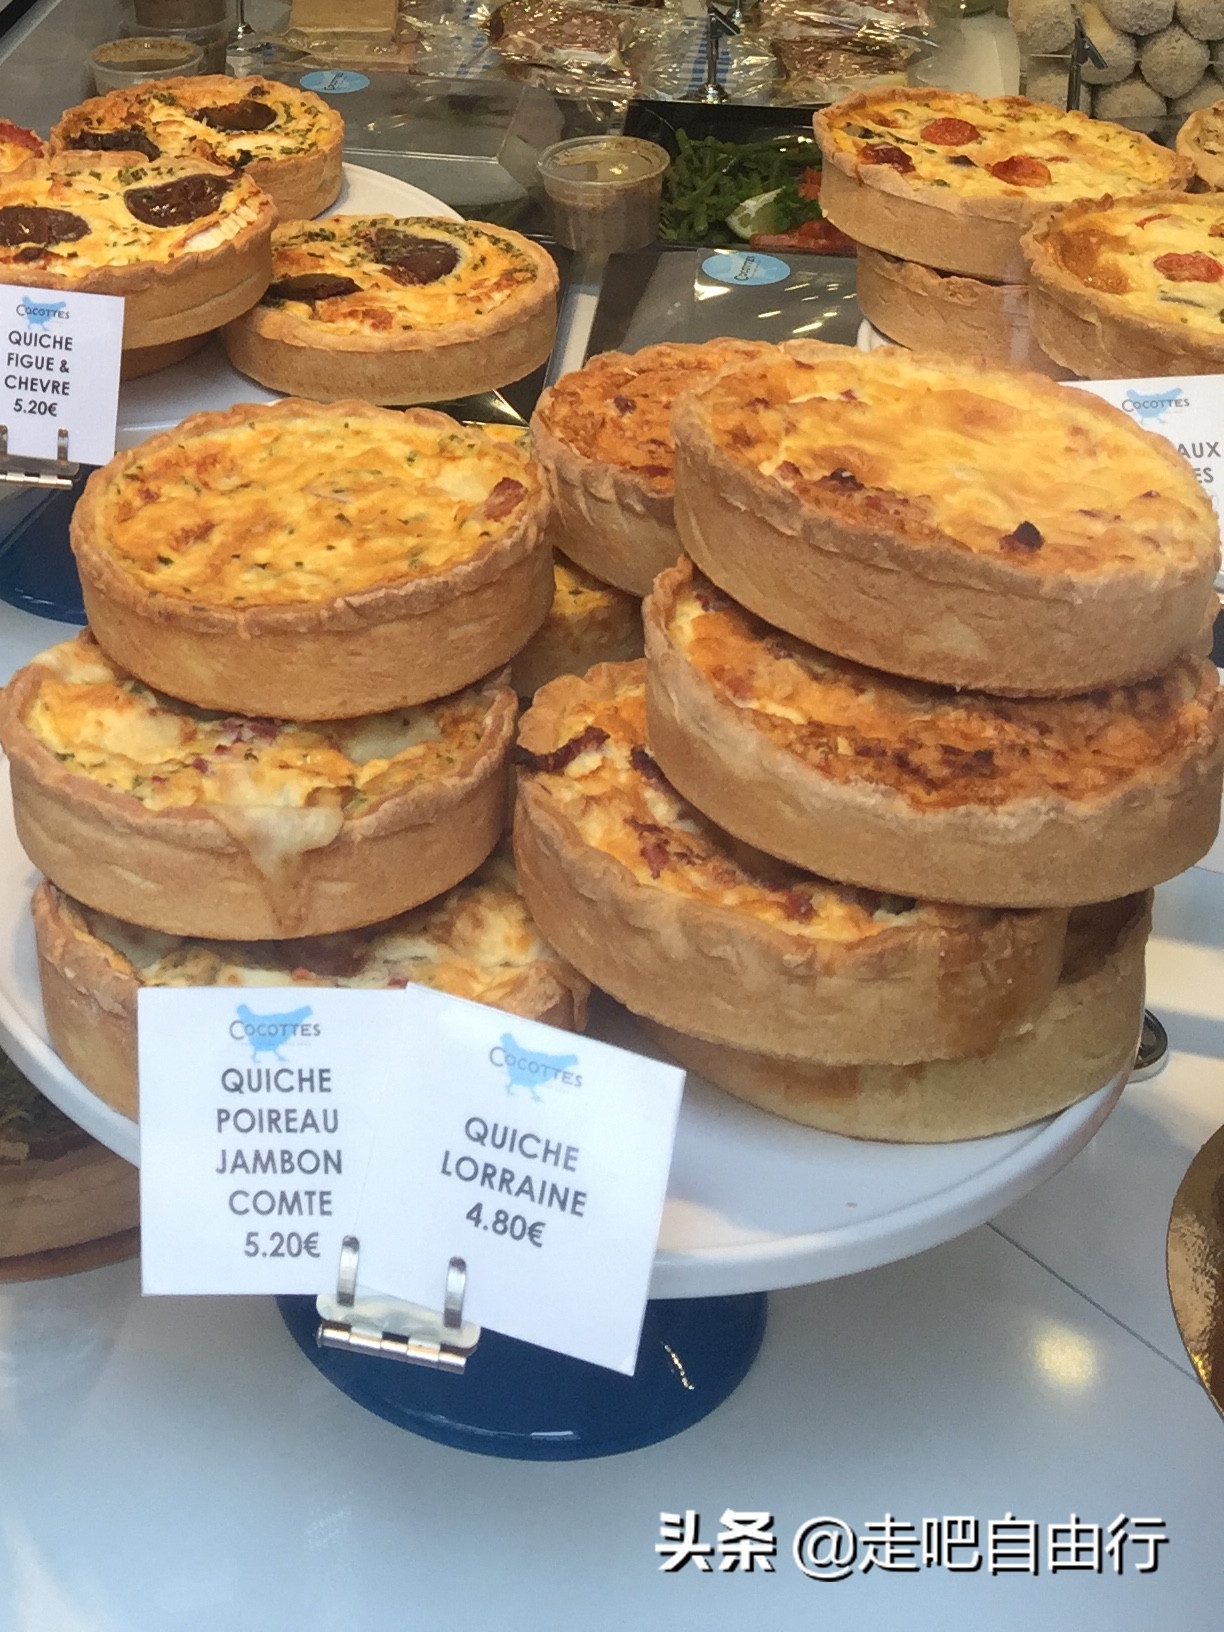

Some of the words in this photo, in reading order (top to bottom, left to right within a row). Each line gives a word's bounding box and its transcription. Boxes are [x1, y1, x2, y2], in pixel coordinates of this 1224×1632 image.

[8, 330, 73, 351] QUICHE
[7, 352, 54, 372] FIGUE
[59, 359, 70, 373] &
[4, 374, 70, 396] CHEVRE
[13, 398, 58, 417] 5.20€
[221, 1067, 332, 1094] QUICHE
[216, 1108, 339, 1134] POIREAU
[464, 1116, 580, 1172] QUICHE
[215, 1149, 343, 1175] JAMBON
[440, 1150, 588, 1218] LORRAINE
[228, 1189, 333, 1217] COMTE
[465, 1201, 547, 1249] 4.80€
[243, 1231, 321, 1258] 5.20€
